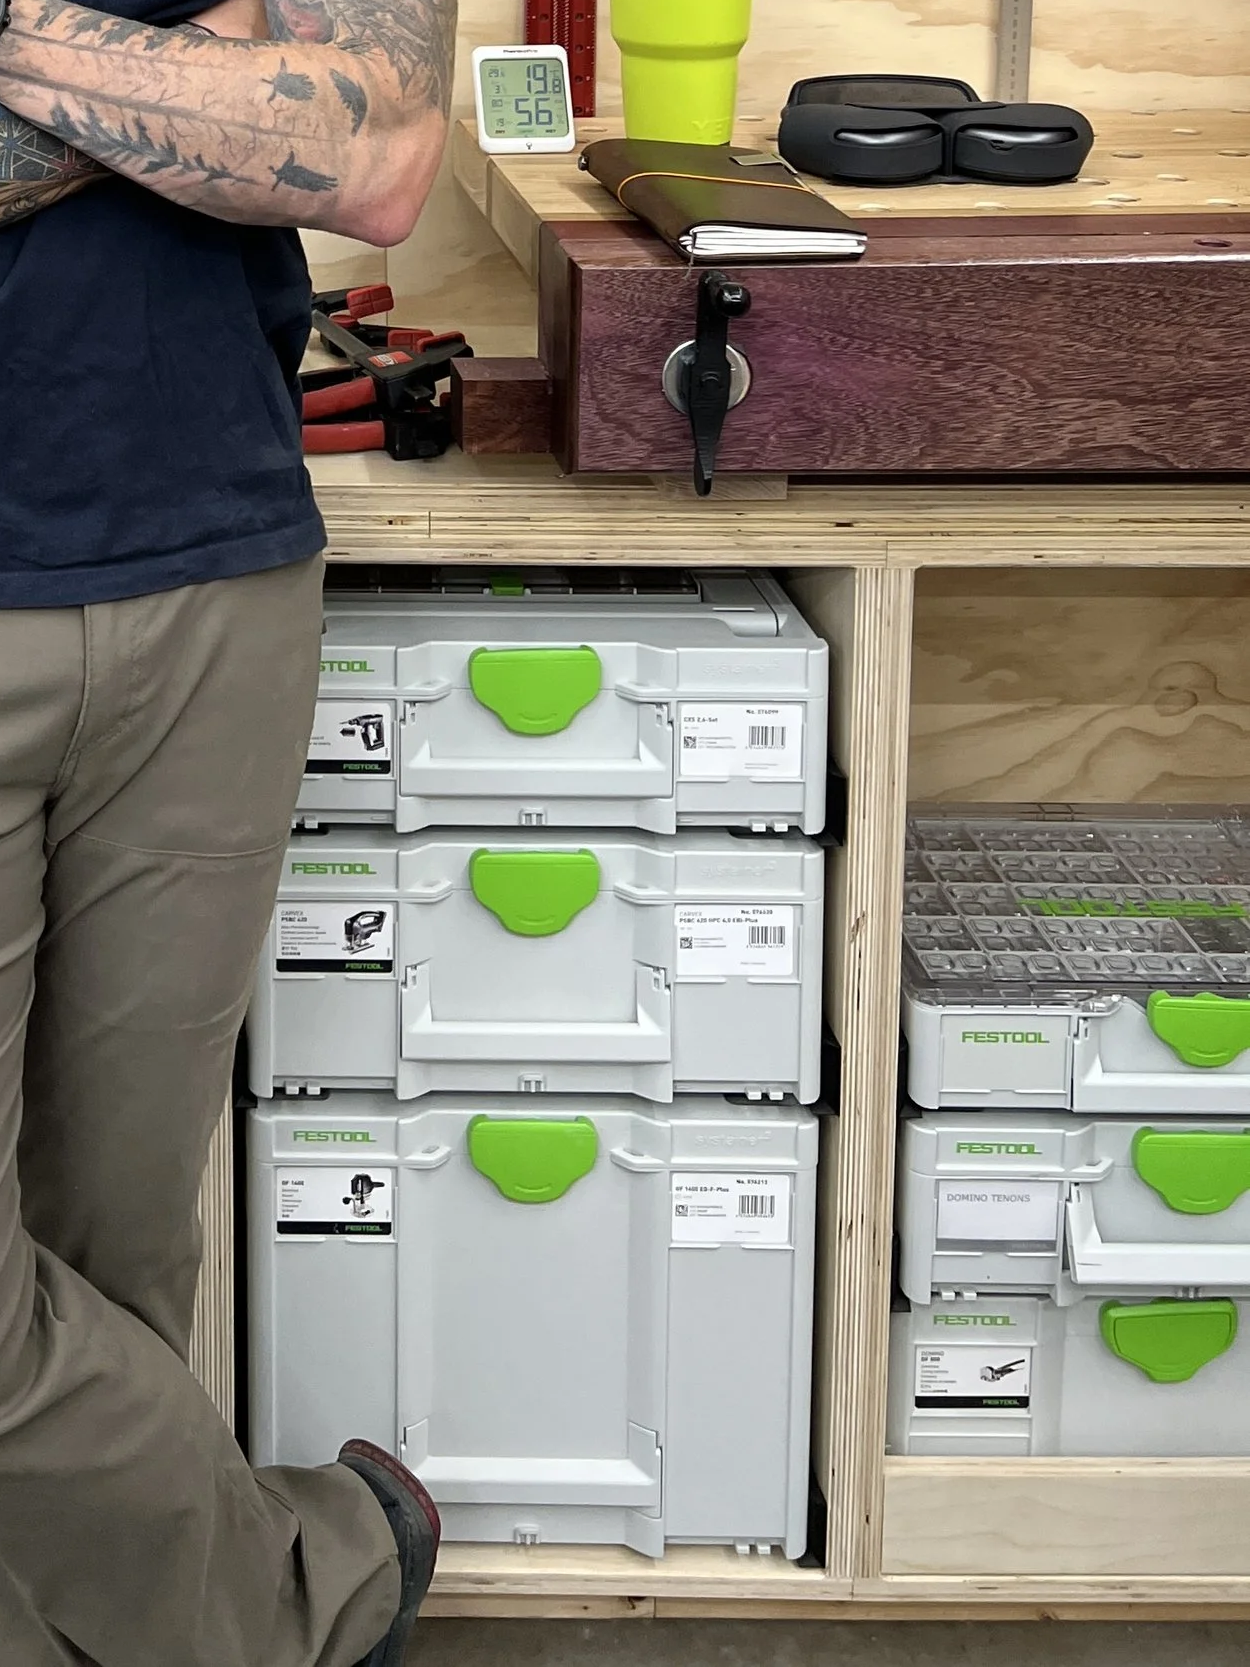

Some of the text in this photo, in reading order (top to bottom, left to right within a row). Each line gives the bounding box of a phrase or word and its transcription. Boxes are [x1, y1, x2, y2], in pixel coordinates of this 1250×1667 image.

[515, 97, 552, 126] 56
[320, 661, 374, 672] STOOL
[291, 862, 377, 874] FESTOOL
[961, 1031, 1049, 1044] FESTOOL
[293, 1131, 377, 1142] FESTOOL
[956, 1142, 1042, 1154] FESTOOL
[947, 1194, 1031, 1202] DOMINO TENONS
[933, 1315, 1017, 1326] FESTOOL
